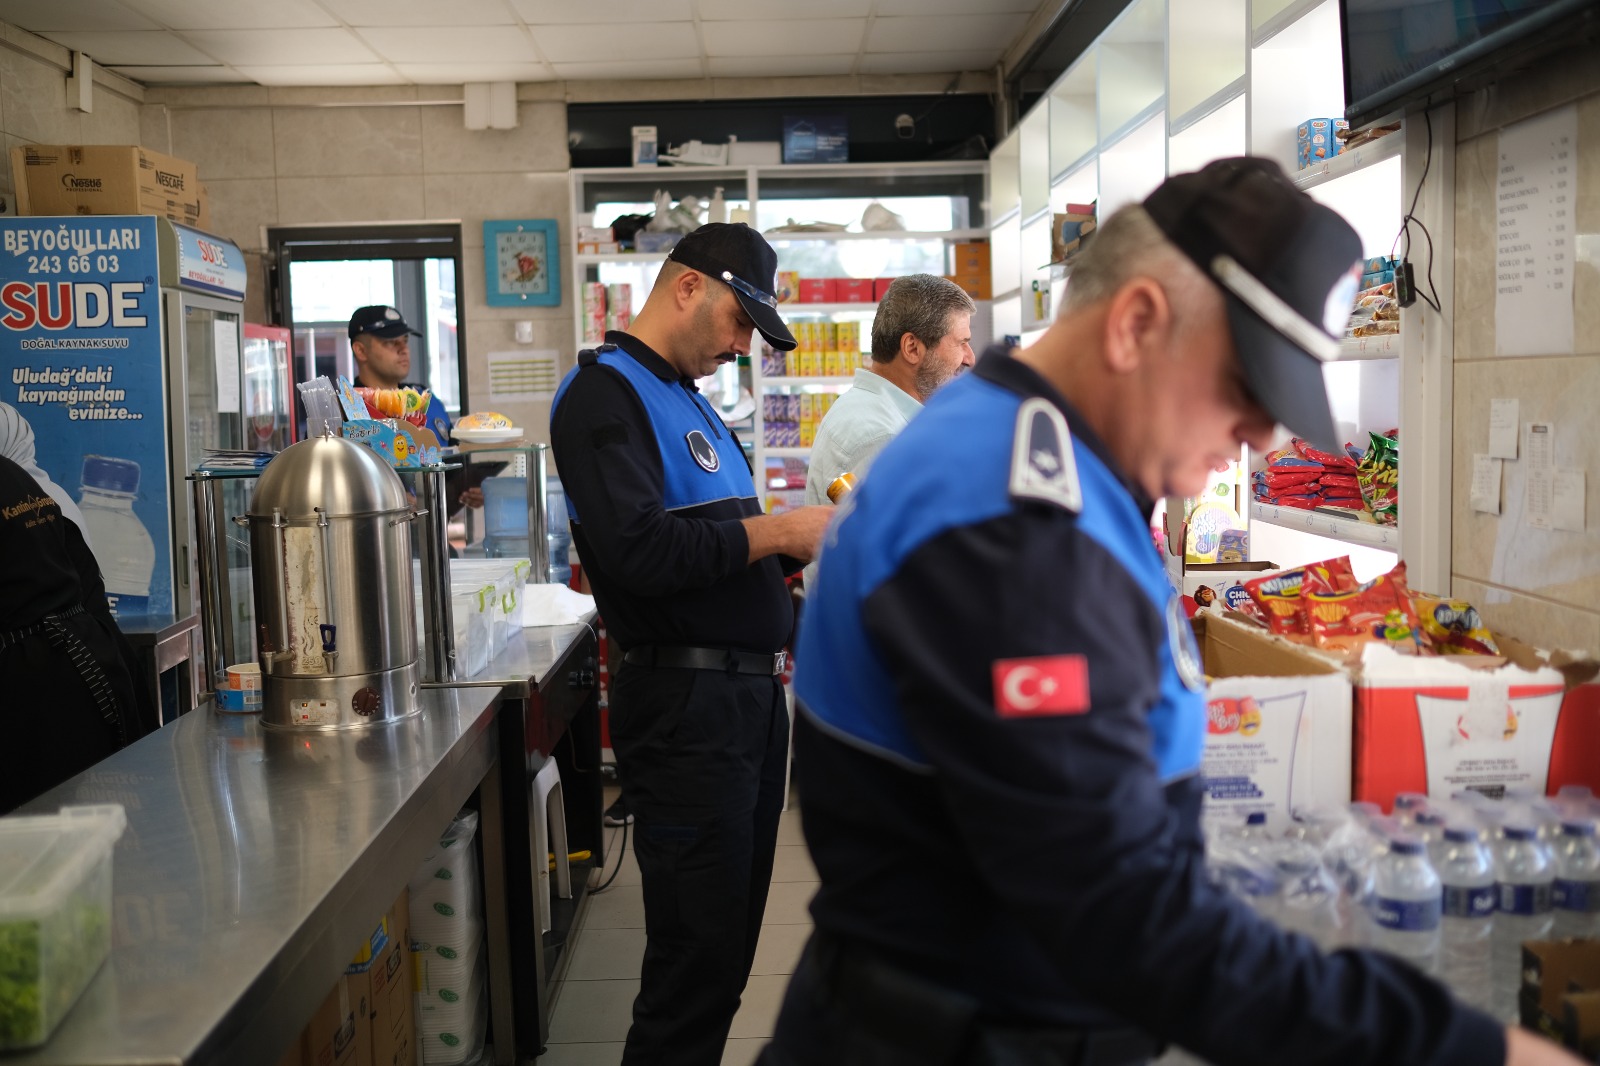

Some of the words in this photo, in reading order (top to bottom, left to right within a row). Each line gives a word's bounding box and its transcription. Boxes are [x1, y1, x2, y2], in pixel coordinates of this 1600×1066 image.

[4, 225, 140, 252] BEYOĞULLARI
[28, 256, 61, 274] 243
[68, 256, 91, 274] 66
[97, 255, 119, 273] 03
[197, 240, 228, 269] SUDE
[1, 281, 147, 331] SUDE
[22, 337, 57, 349] DOĞAL
[59, 338, 101, 349] KAYNAK
[102, 338, 129, 349] SUYU
[13, 366, 113, 386] Uludağ'daki
[18, 385, 126, 405] kaynağından
[69, 403, 143, 420] evinize...
